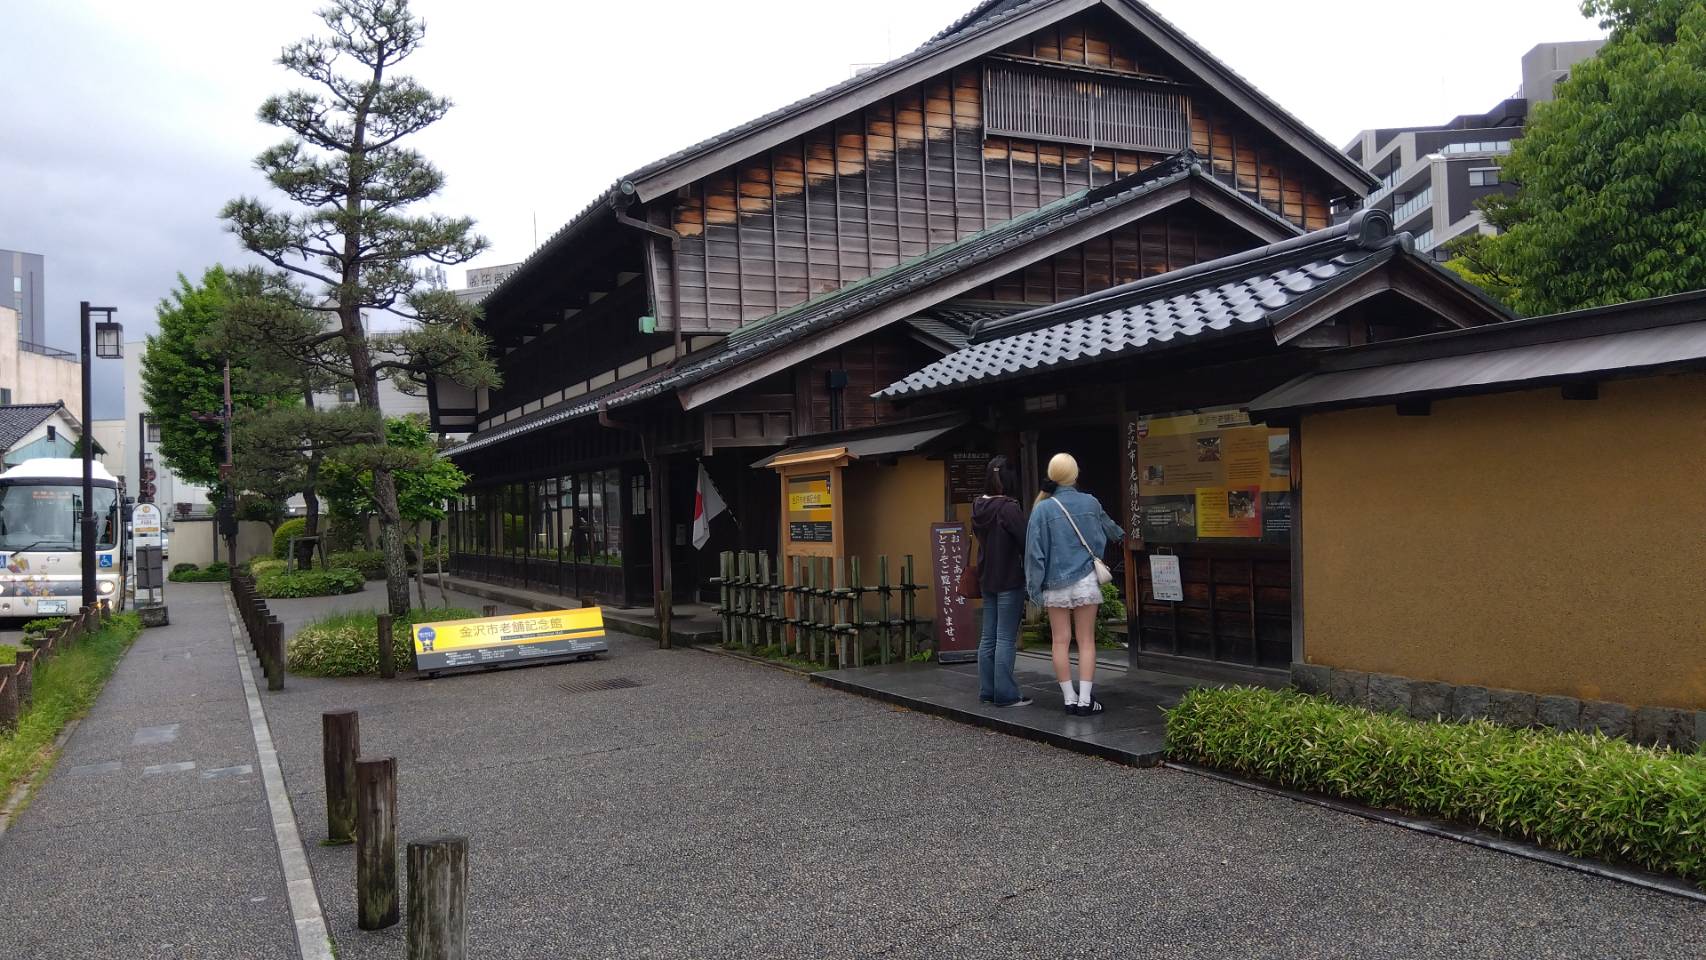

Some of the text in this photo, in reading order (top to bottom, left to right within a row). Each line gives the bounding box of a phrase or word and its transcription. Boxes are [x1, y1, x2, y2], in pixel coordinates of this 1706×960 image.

[460, 617, 563, 638] 金沢市老舗記念館
